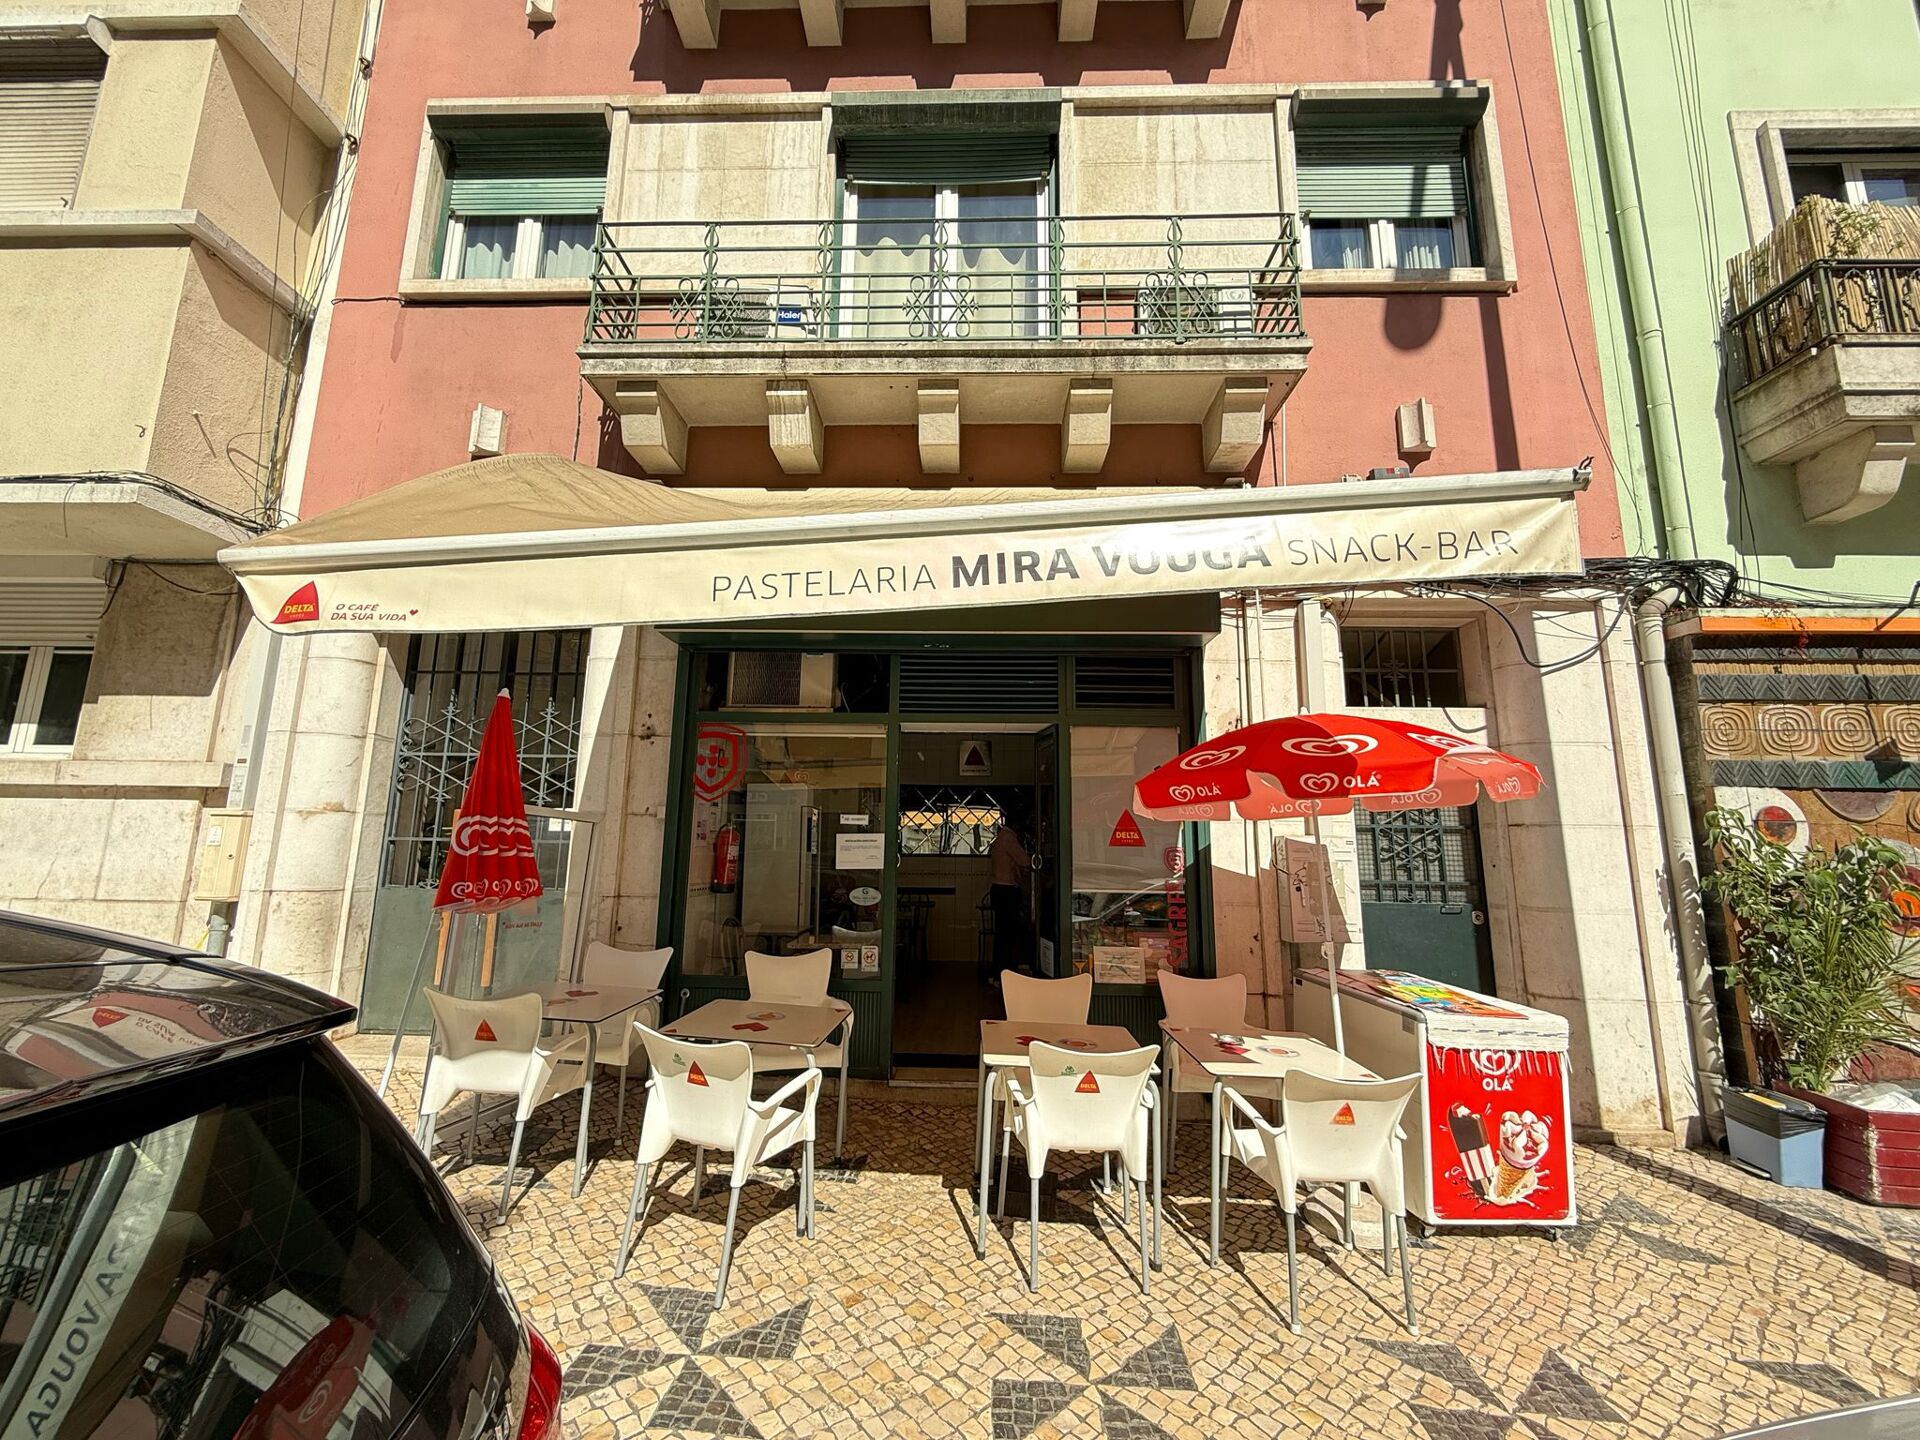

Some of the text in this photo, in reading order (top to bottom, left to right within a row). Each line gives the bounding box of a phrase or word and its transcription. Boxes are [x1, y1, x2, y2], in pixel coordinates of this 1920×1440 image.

[778, 310, 801, 319] Haier
[712, 529, 1519, 602] PASTELARIA MIRA VOUGA SNACK-BAR
[284, 604, 314, 614] DELTA
[348, 603, 379, 611] CAFÉ
[330, 612, 407, 621] DA SUA VIDA
[1342, 771, 1380, 788] OLÁ
[1196, 782, 1222, 797] OLÁ
[1115, 831, 1140, 839] DELTA
[1482, 1075, 1513, 1091] OLÁ
